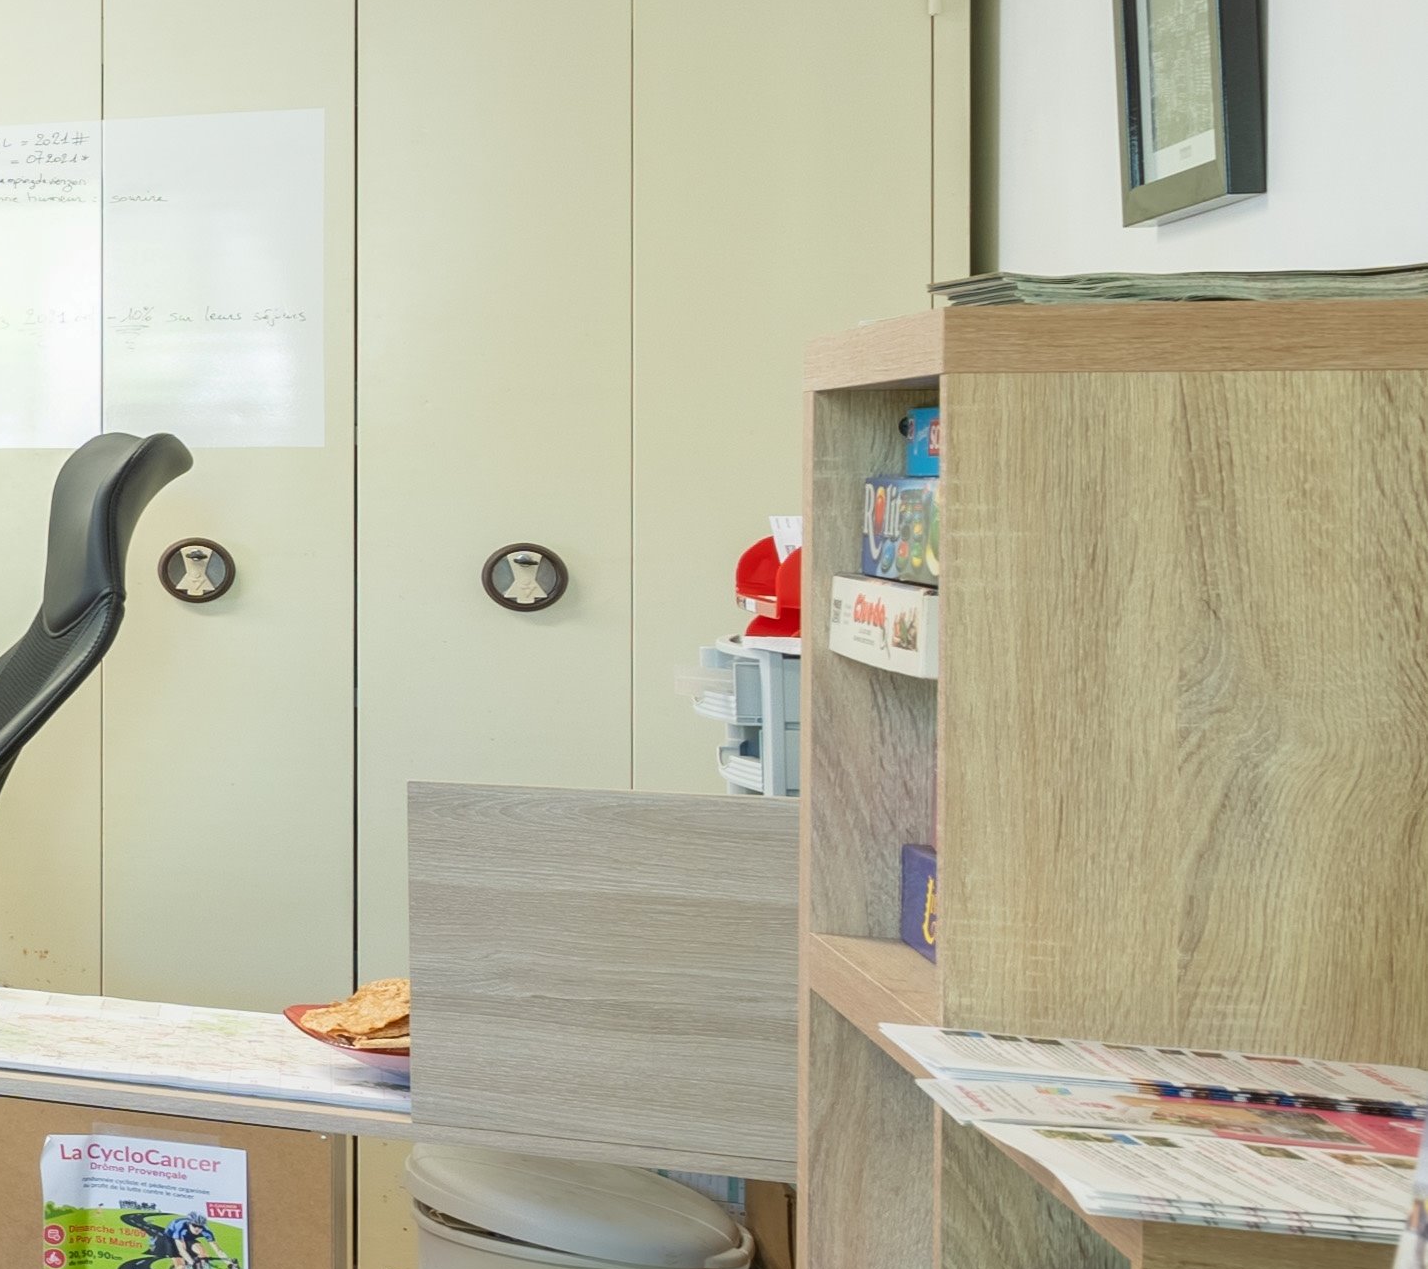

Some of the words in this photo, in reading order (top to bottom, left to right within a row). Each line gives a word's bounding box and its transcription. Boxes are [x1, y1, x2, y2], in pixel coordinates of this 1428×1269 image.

[204, 306, 243, 324] leurs
[60, 1143, 82, 1160] La
[87, 1143, 222, 1173] CycloCancer
[90, 1161, 125, 1174] Drôme
[127, 1165, 188, 1181] Provençale
[218, 1208, 242, 1218] VTT
[68, 1225, 115, 1235] Dimanche
[109, 1236, 143, 1249] Martin
